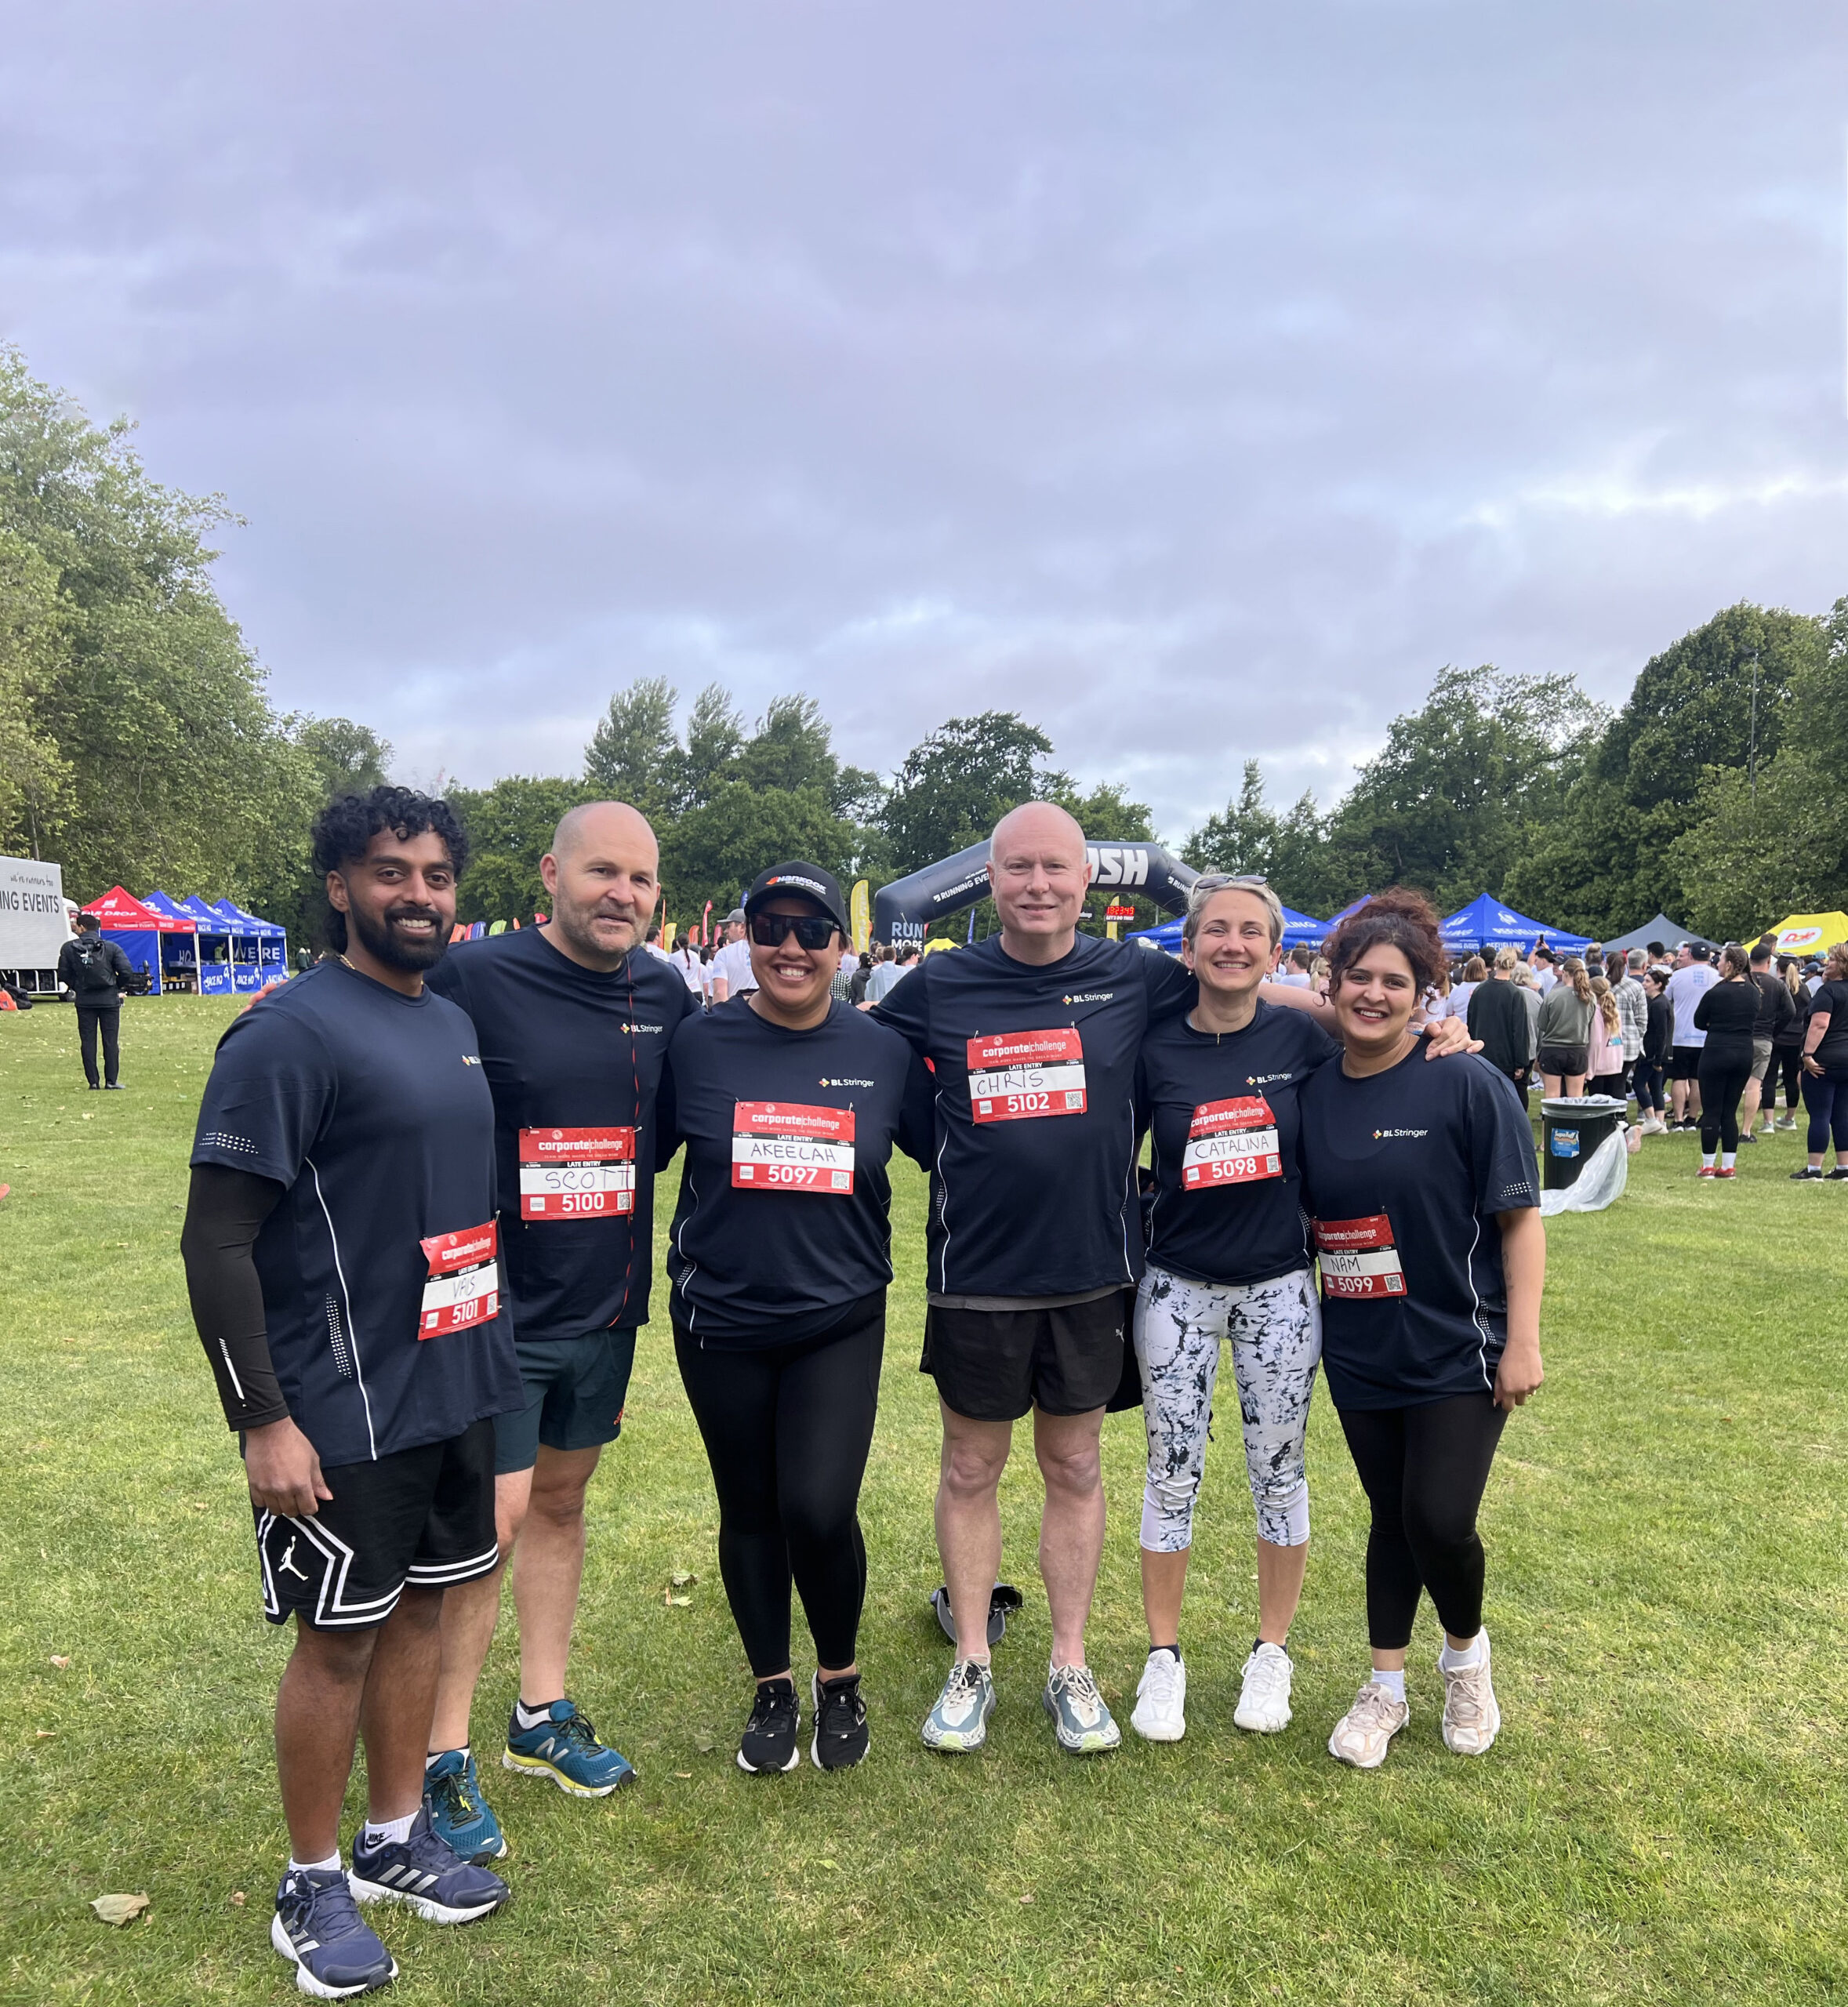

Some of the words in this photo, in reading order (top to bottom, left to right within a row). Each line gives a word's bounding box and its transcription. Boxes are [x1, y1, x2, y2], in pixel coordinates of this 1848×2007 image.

[1086, 847, 1149, 885] ISH
[941, 880, 974, 900] RUNNING
[1172, 879, 1191, 895] RUNN
[22, 892, 60, 913] EVENTS
[891, 922, 923, 938] RUN
[1492, 927, 1557, 937] REFUELLING
[1073, 994, 1085, 1003] BL
[1084, 993, 1113, 1002] Stringer
[640, 1024, 663, 1034] Stringer
[843, 1078, 875, 1087] Stringer
[1257, 1076, 1268, 1084] BL
[1267, 1072, 1292, 1081] Stringer
[1008, 1093, 1050, 1112] 5102
[1393, 1128, 1429, 1138] Stringer
[750, 1142, 837, 1163] AKEELAH
[1195, 1135, 1269, 1159] CATALINA
[768, 1165, 819, 1185] 5097
[1211, 1157, 1257, 1179] 5098
[546, 1167, 631, 1190] SCOTT
[561, 1192, 605, 1212] 5100
[1331, 1256, 1361, 1273] NAM
[1338, 1276, 1374, 1293] 5099
[452, 1299, 479, 1325] 5101
[368, 1832, 385, 1842] NIKE
